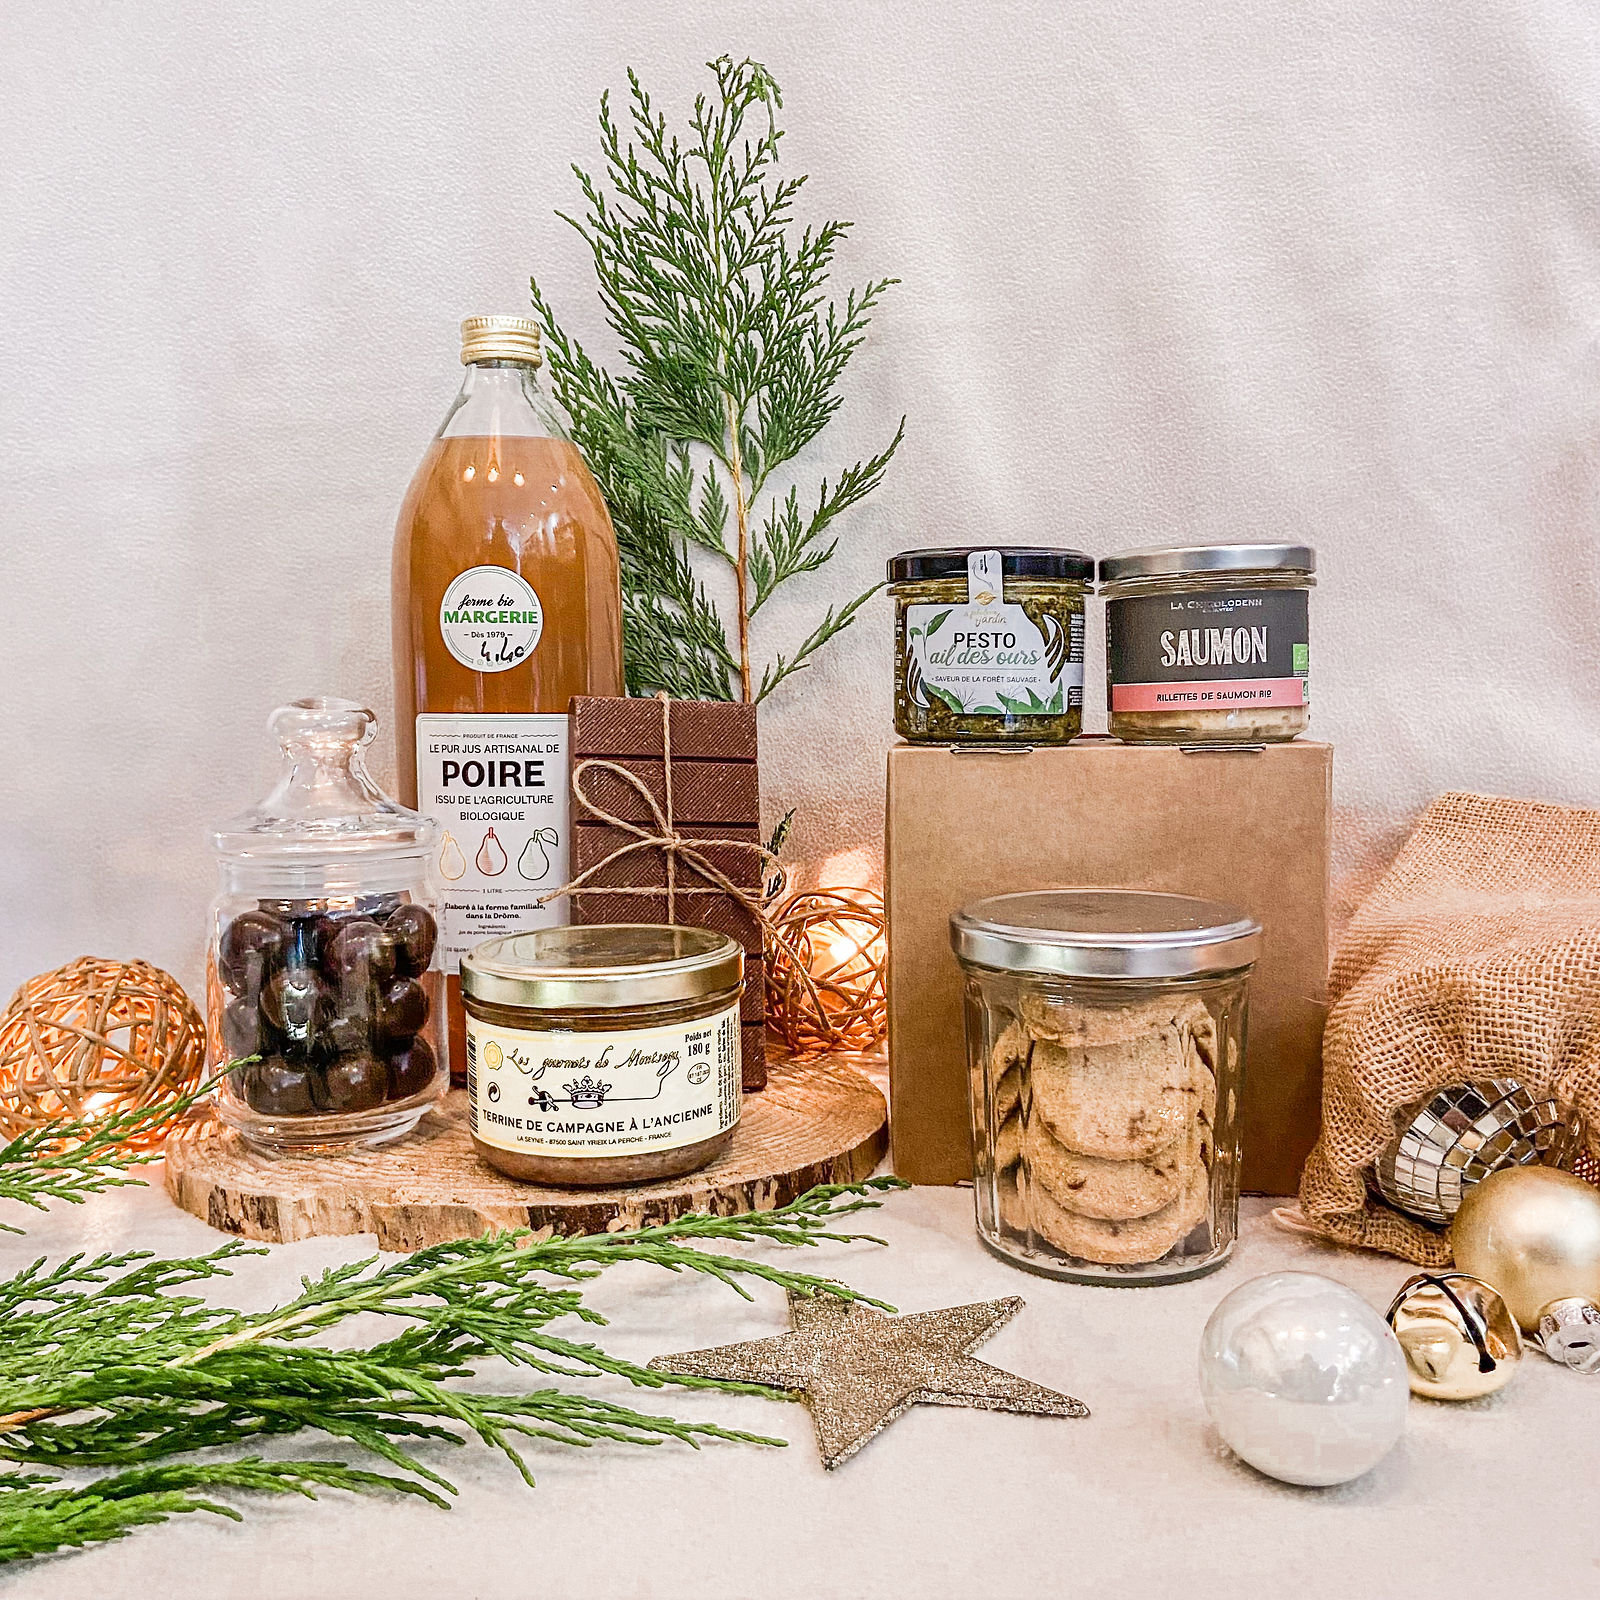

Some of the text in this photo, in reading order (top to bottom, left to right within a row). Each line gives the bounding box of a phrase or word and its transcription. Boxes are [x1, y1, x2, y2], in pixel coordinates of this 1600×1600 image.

[457, 593, 515, 610] ferme bio
[1170, 602, 1184, 610] LA
[443, 610, 539, 624] MARGERIE
[953, 632, 1016, 649] PESTO
[1160, 626, 1268, 667] SAUMON
[929, 643, 1042, 666] ail des ours
[983, 674, 1005, 683] FORÊT
[1007, 676, 1038, 684] SAUVAGE
[1156, 692, 1198, 702] RILLETTES
[1201, 692, 1214, 701] DE
[1216, 690, 1256, 700] SAUMON
[429, 743, 559, 754] LE PUR JUS ARTISANAL DE
[442, 760, 545, 787] POIRE
[435, 794, 554, 805] ISSU DE L'AGRICULTURE
[460, 811, 525, 821] BIOLOGIQUE
[477, 903, 484, 911] la
[485, 903, 509, 911] ferme
[685, 1031, 702, 1043] Poids
[688, 1042, 711, 1056] 180 g
[507, 1048, 533, 1074] Les
[482, 1103, 713, 1134] TERRINE DE CAMPAGNE À L'ANCIENNE
[567, 1138, 585, 1146] SAINT
[617, 1136, 643, 1144] PERCHE
[648, 1131, 672, 1141] FRANCE
